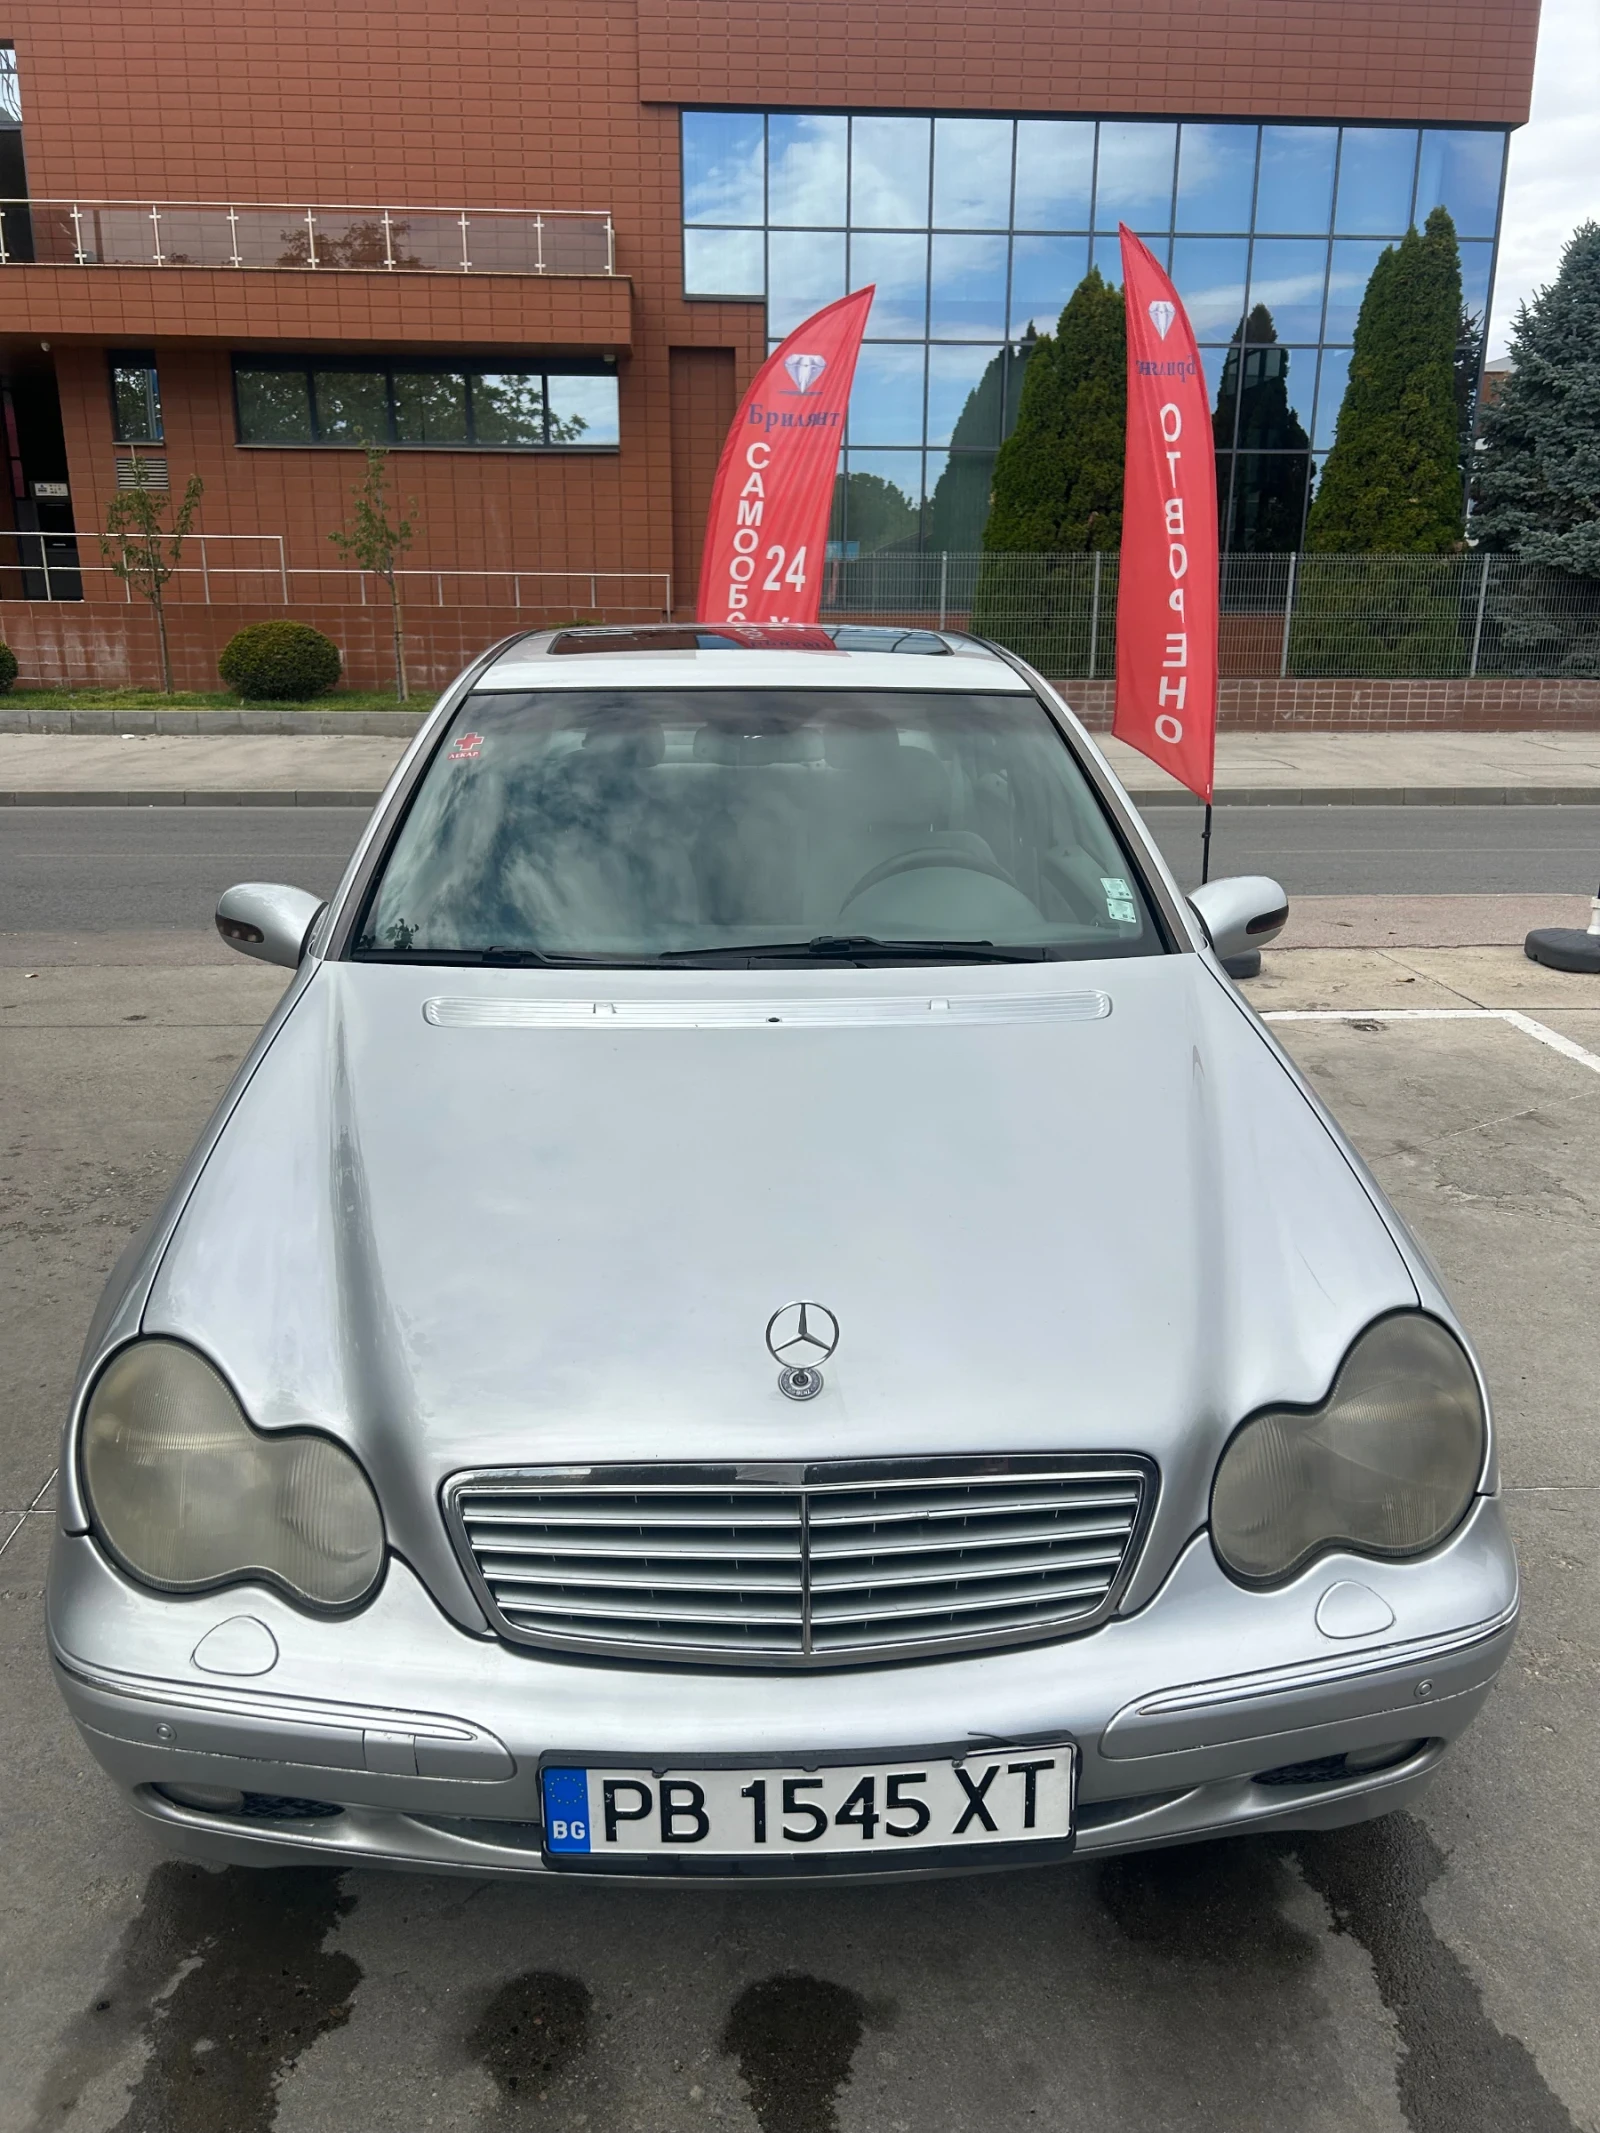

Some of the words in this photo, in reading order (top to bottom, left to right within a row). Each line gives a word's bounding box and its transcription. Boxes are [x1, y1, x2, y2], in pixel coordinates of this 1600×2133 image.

[762, 545, 807, 592] 24
[603, 1779, 710, 1844] PB
[740, 1772, 931, 1844] 1545
[951, 1759, 1056, 1834] XT
[552, 1820, 586, 1840] BG
